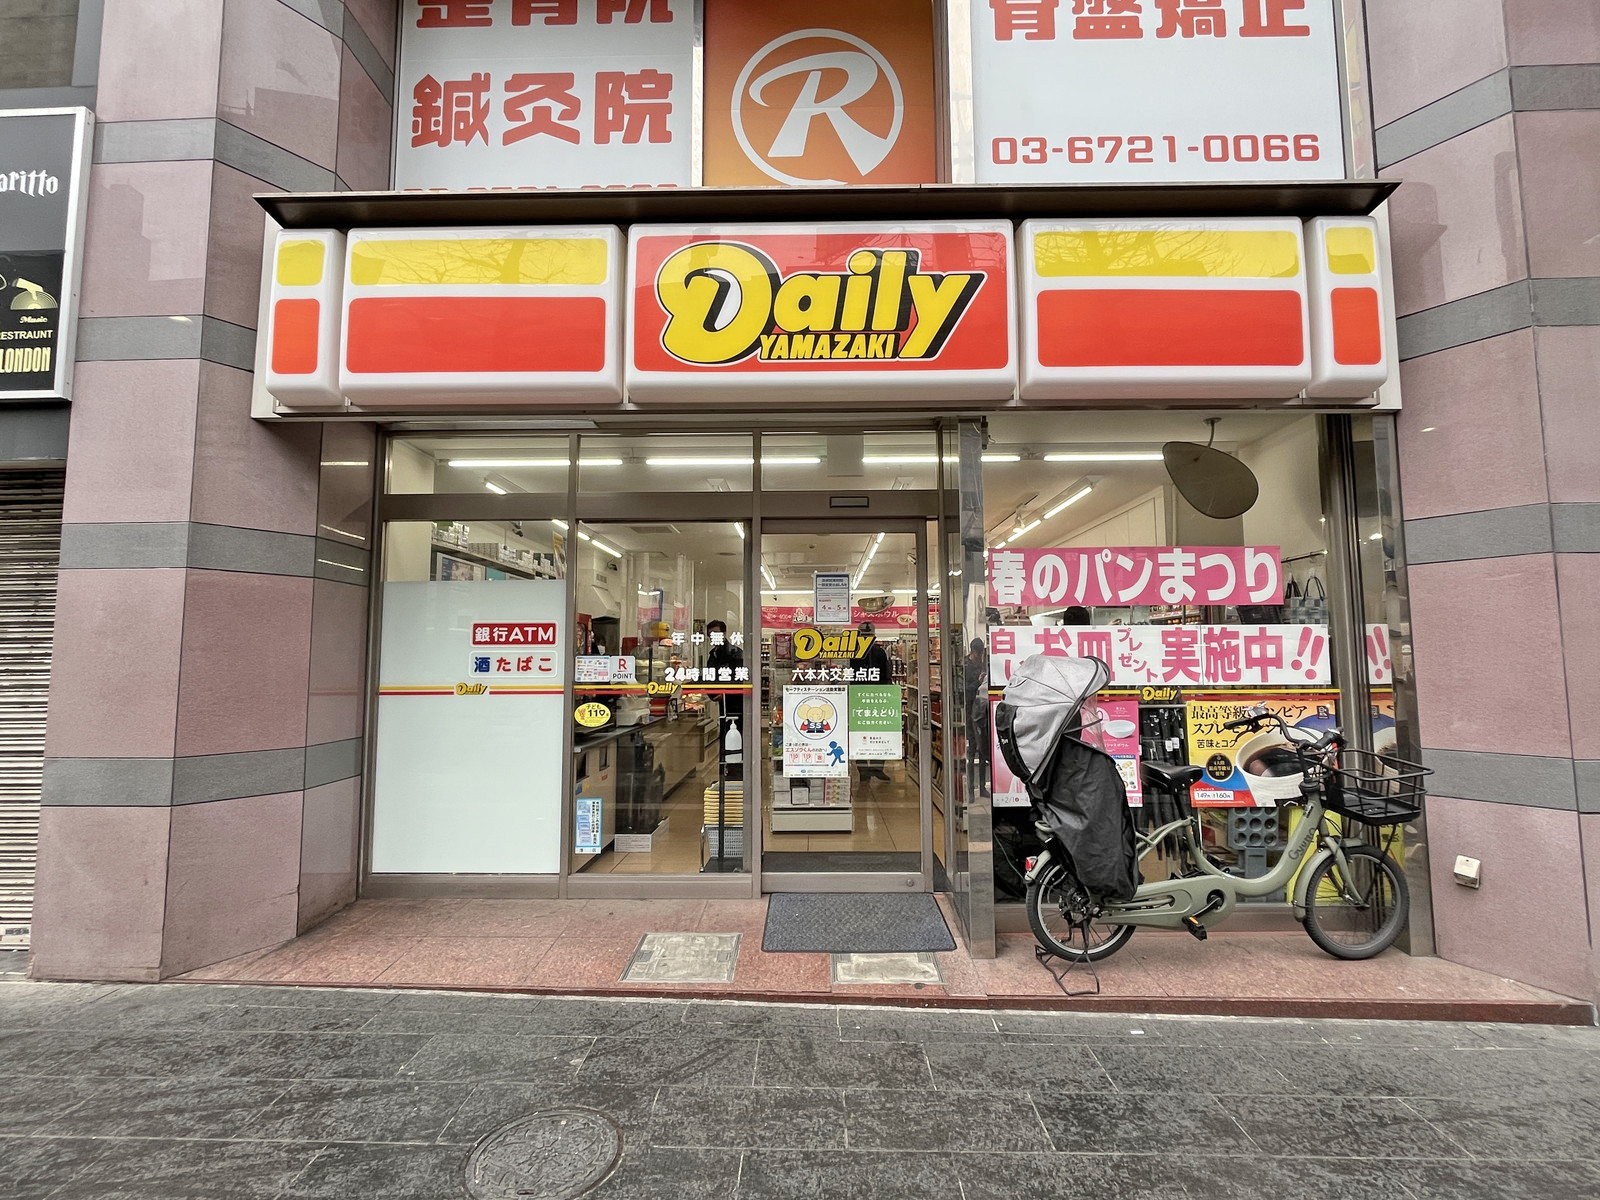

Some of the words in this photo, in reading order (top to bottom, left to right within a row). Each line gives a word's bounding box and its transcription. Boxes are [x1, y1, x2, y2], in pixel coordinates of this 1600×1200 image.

[411, 69, 674, 148] 鍼灸院
[992, 134, 1321, 165] 03-6721-0066
[655, 241, 987, 365] Daily
[760, 333, 897, 360] YAMAZAKI
[0, 347, 51, 374] LONDON
[992, 547, 1278, 605] 春のパンまつり
[475, 627, 554, 642] 銀行ATM
[671, 632, 744, 646] 年中無休
[793, 628, 876, 660] Daily
[819, 651, 856, 659] YAMAZAKI
[664, 667, 750, 682] 24時間営業
[791, 667, 881, 682] 六本木交差点店
[456, 682, 488, 696] Daily
[647, 681, 679, 695] Daily
[1142, 686, 1178, 701] Daily
[1197, 739, 1237, 749] 苦味とコク
